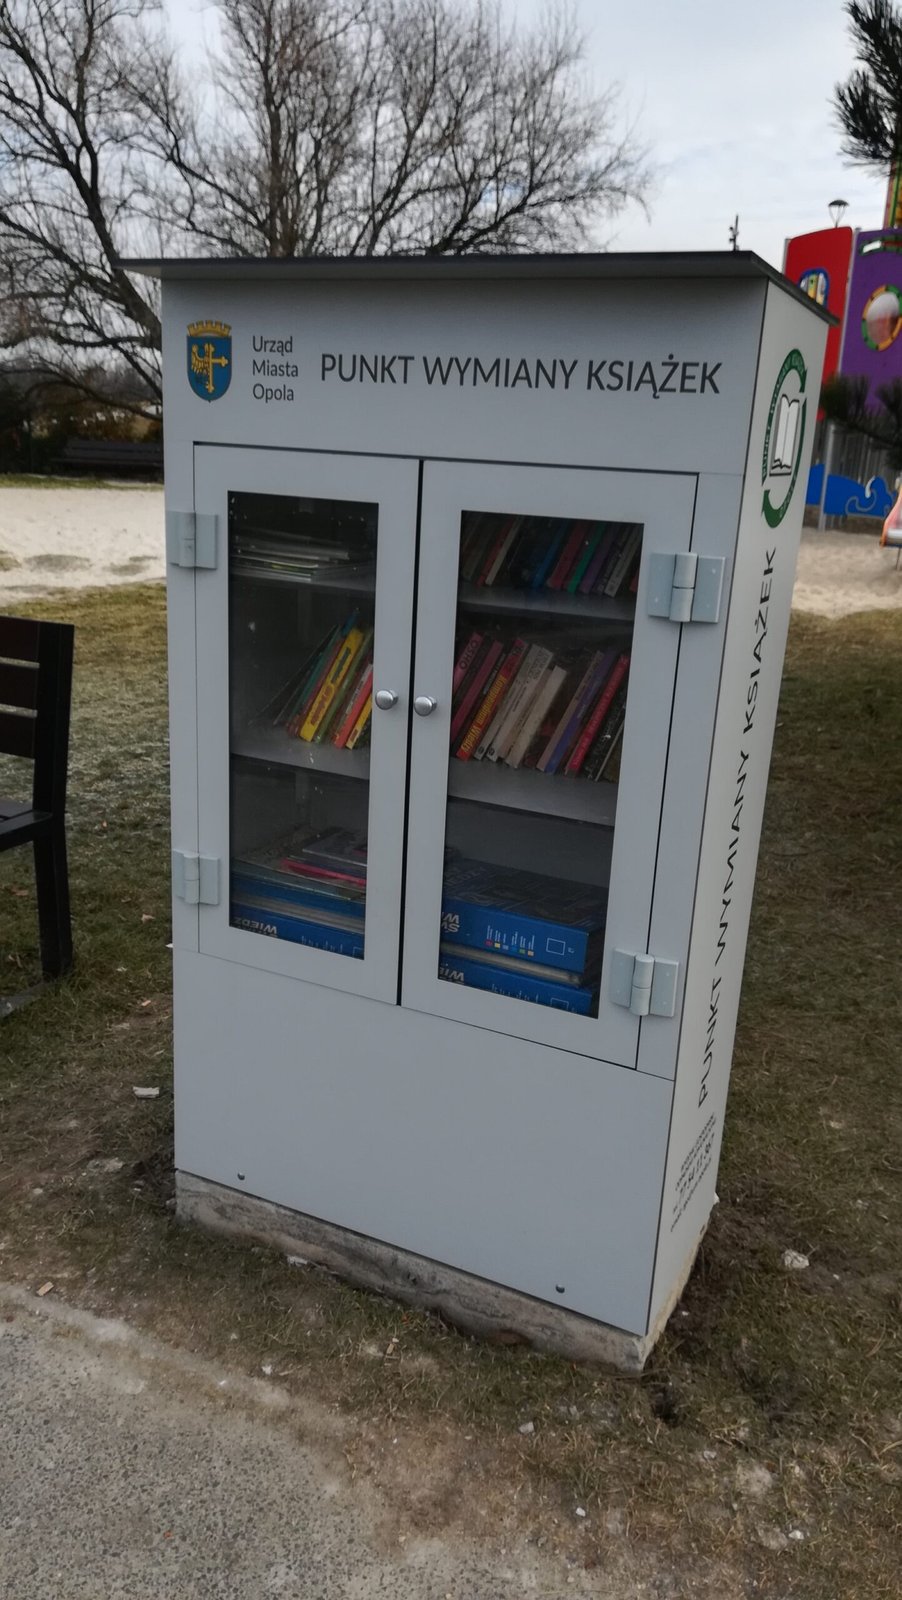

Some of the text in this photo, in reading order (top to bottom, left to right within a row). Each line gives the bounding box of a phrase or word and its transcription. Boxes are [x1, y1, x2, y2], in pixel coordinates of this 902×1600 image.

[252, 335, 293, 357] Urząd
[252, 358, 298, 377] Miasta
[321, 353, 723, 400] PUNKT WYMIANY KSIĄŻEK
[253, 383, 294, 403] Opola
[459, 640, 478, 671] OSHO
[698, 546, 777, 1109] PUNKT WYMIANY KSIĄŻEK
